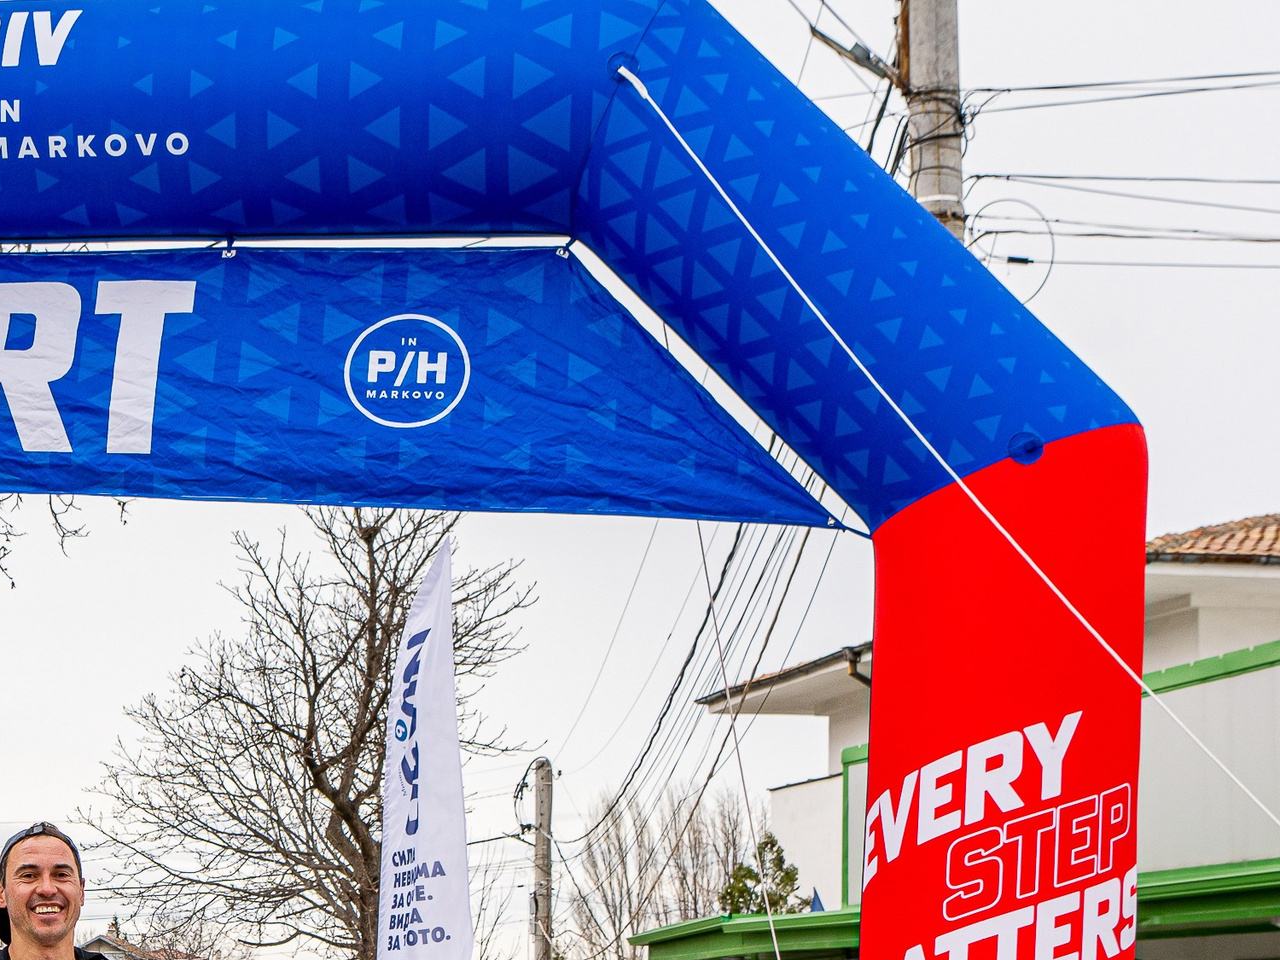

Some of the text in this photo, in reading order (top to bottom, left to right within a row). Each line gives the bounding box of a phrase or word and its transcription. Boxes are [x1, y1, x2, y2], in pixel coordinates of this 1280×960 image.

[401, 337, 417, 346] IN
[367, 350, 448, 387] P/H
[366, 389, 445, 400] MARKOVO
[862, 710, 1083, 893] EVERY
[942, 783, 1131, 922] STEP
